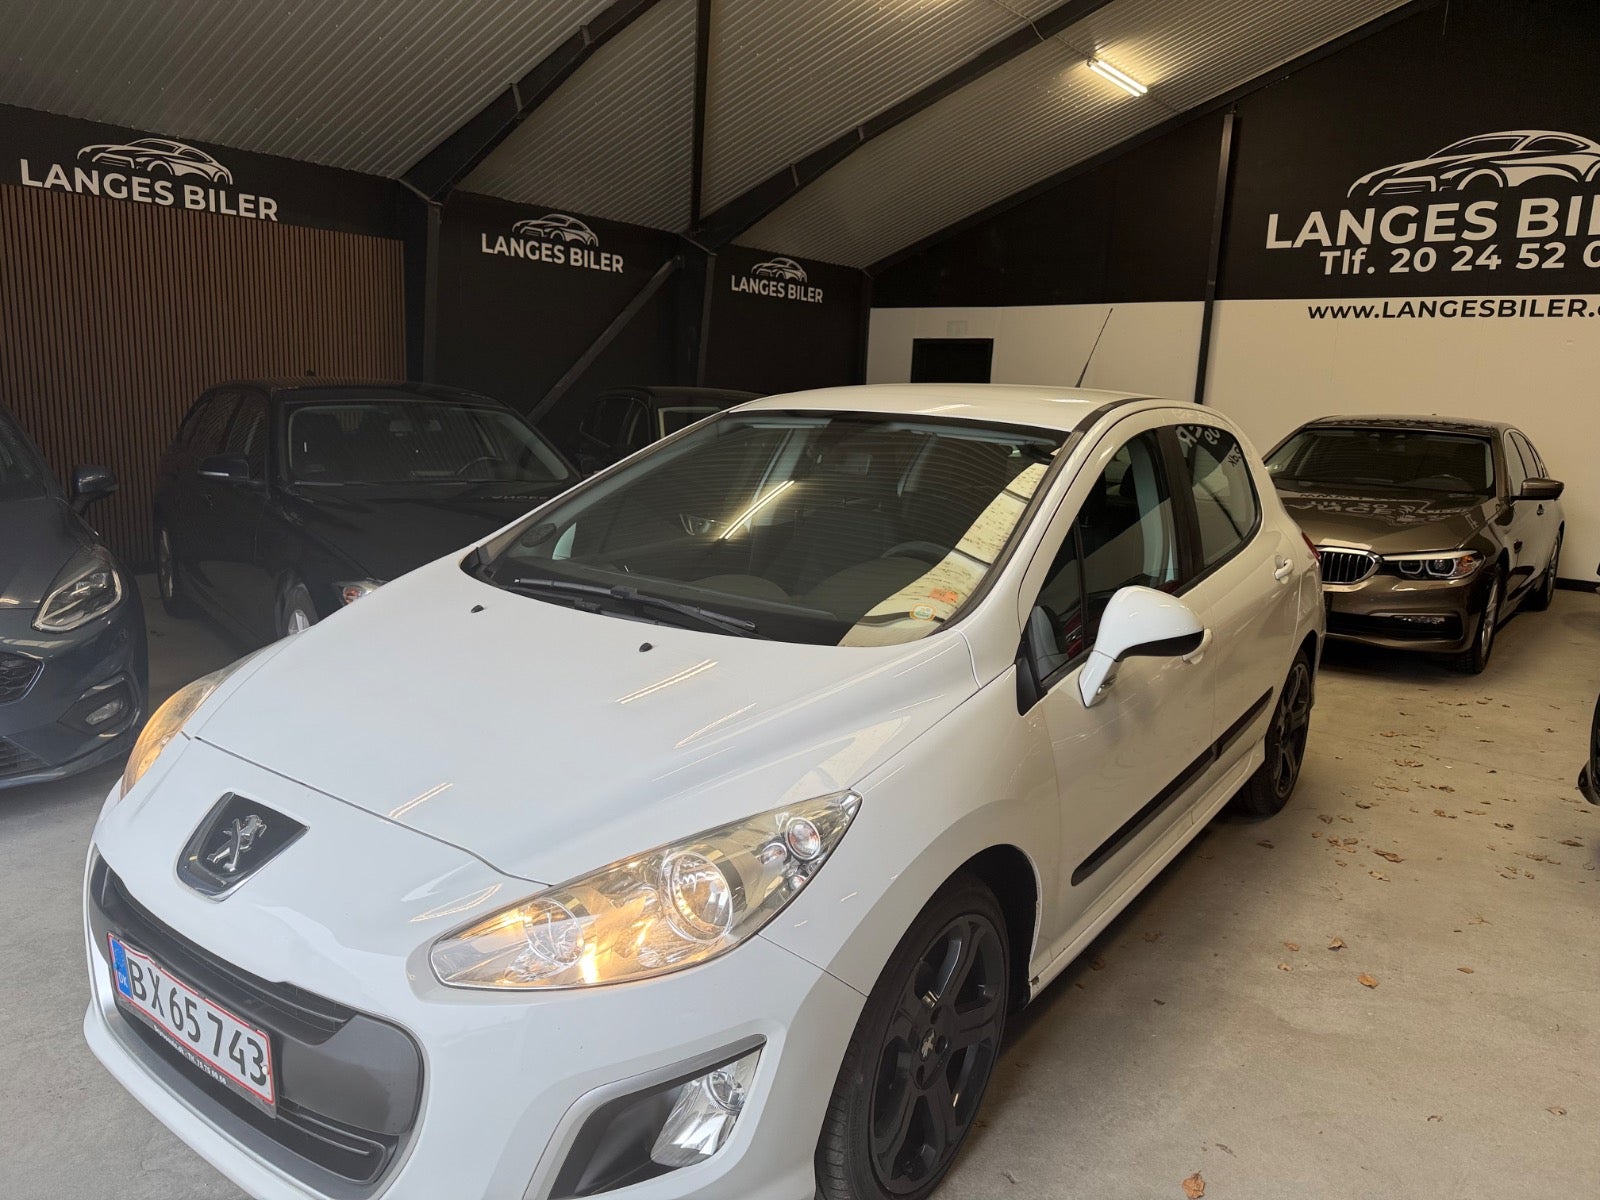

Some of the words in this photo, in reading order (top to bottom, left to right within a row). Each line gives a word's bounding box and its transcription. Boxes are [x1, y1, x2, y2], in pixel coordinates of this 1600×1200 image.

[20, 158, 175, 206] LANGES
[183, 184, 278, 222] BILER
[1265, 200, 1499, 249] LANGES
[481, 233, 565, 264] LANGES
[570, 247, 624, 274] BILER
[1319, 247, 1375, 275] Tlf.
[1390, 247, 1437, 273] 20
[1451, 244, 1502, 272] 24
[1515, 241, 1567, 270] 52
[731, 275, 785, 298] LANGES
[787, 283, 823, 303] BILER
[1307, 299, 1600, 319] www.LANGESBILER.
[127, 956, 165, 1018] BX
[169, 987, 201, 1043] 65
[207, 1010, 268, 1087] 743
